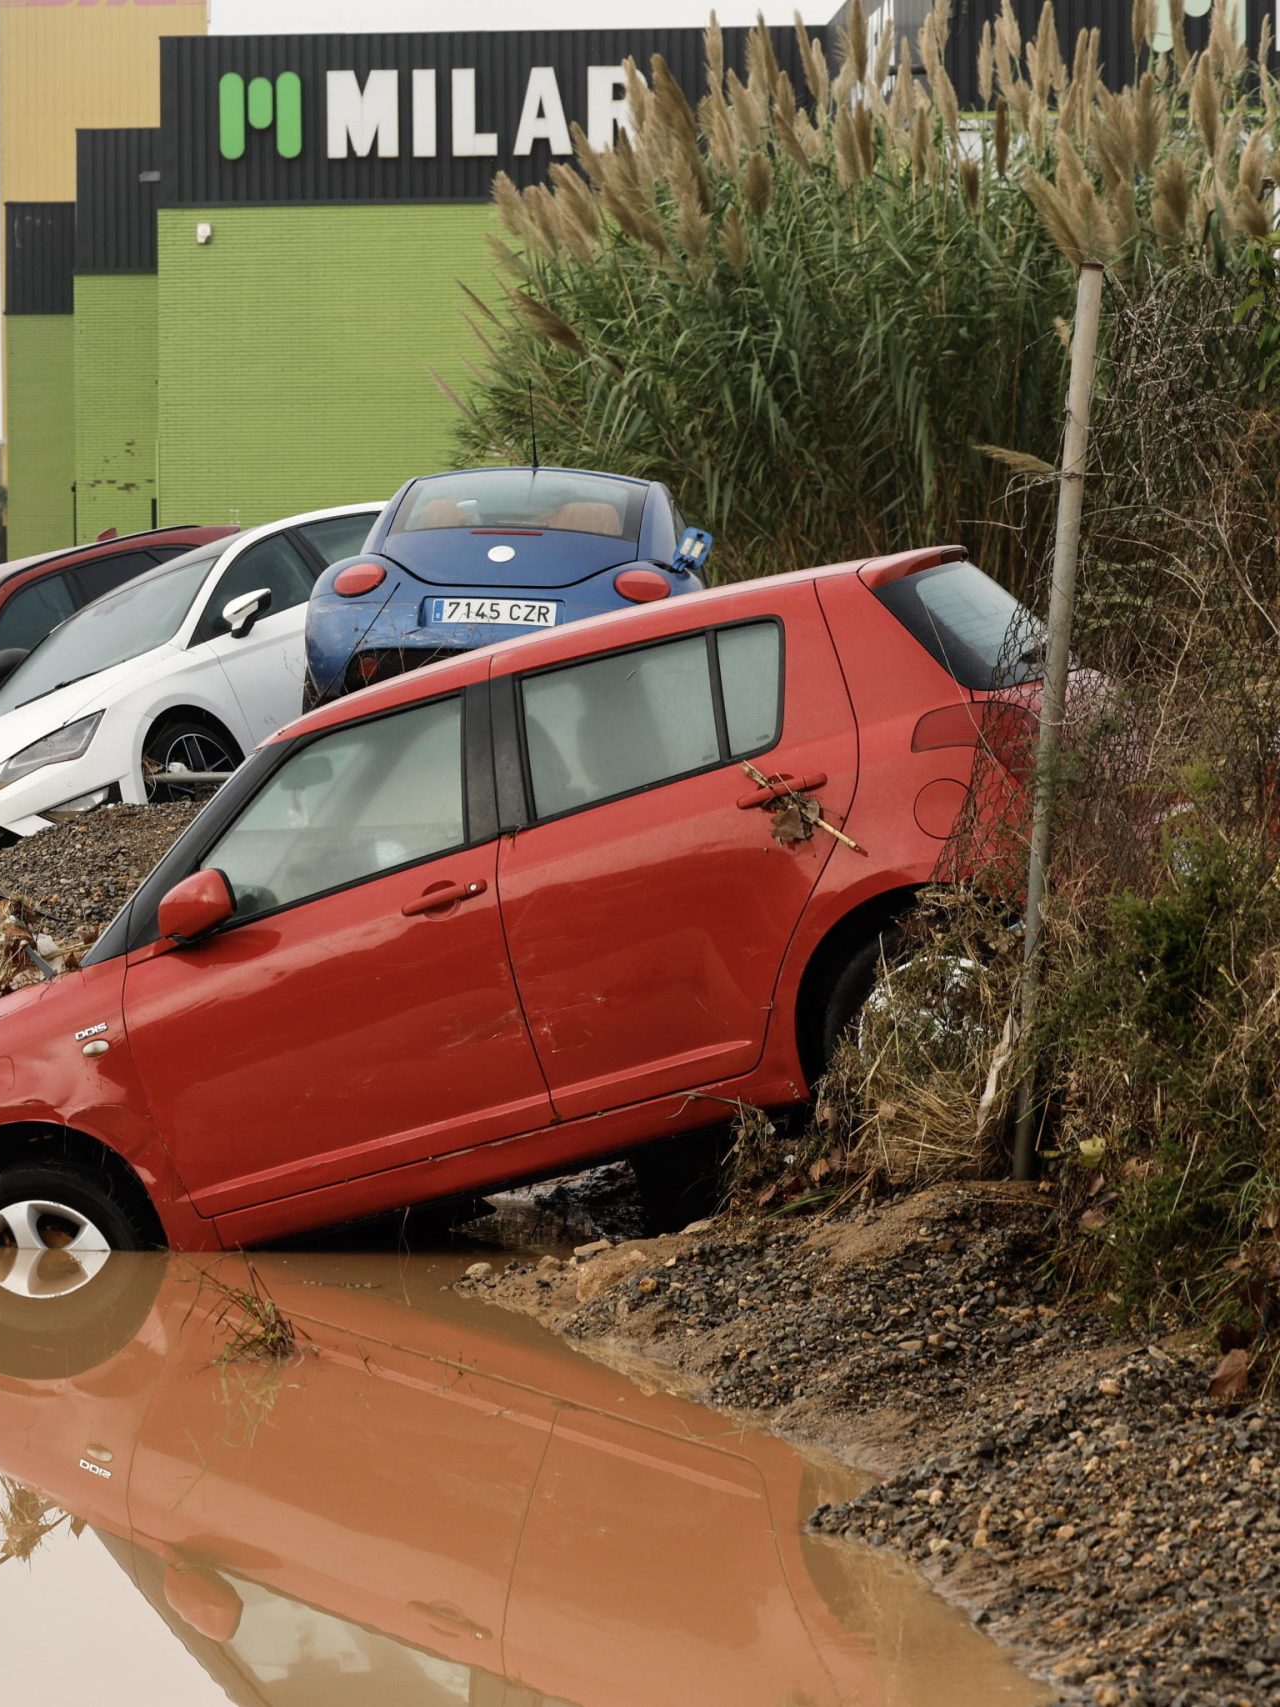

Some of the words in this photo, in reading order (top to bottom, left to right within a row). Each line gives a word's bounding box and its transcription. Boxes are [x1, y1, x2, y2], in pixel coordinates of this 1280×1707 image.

[326, 66, 649, 159] MILAR
[447, 602, 501, 620] 7145
[509, 604, 550, 623] CZR
